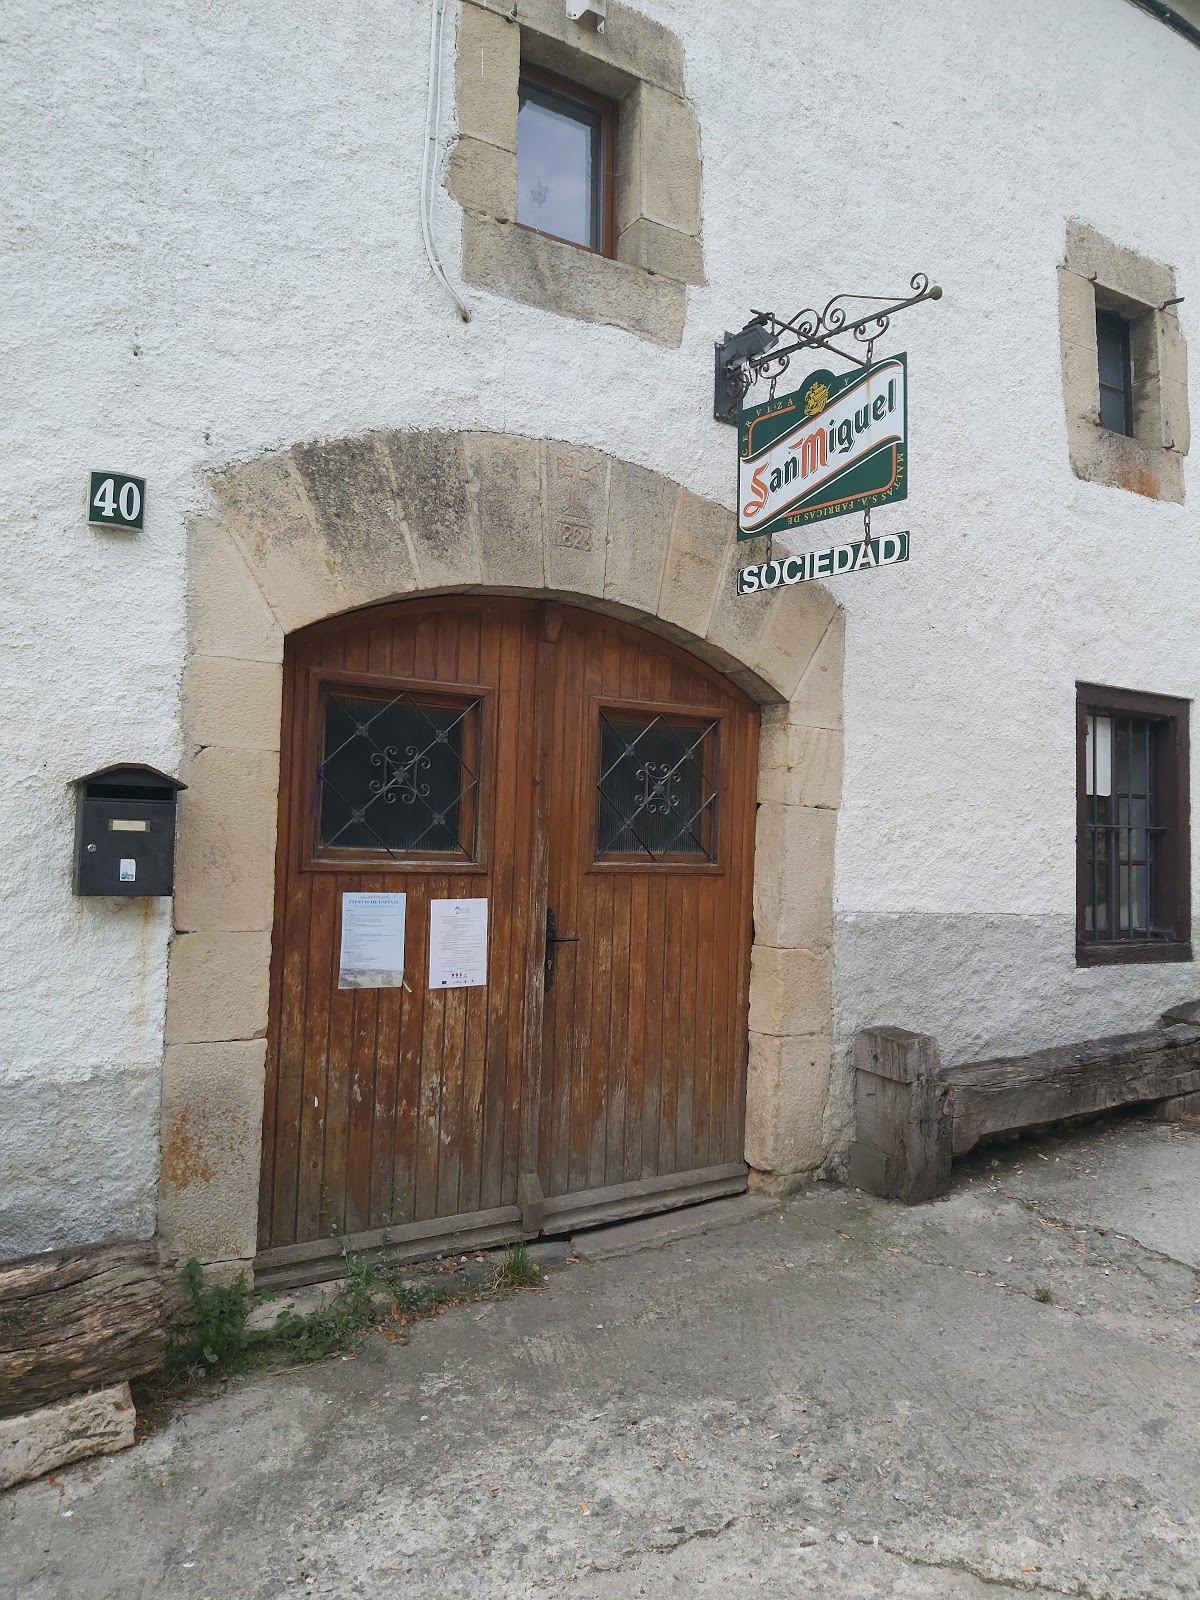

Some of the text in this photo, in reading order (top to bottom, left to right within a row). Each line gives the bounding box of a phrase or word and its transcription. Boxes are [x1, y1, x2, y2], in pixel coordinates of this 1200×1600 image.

[742, 398, 794, 456] CERVEZA
[881, 453, 904, 501] MALTAS
[743, 378, 896, 518] San Miguel
[93, 478, 141, 521] 40
[787, 501, 854, 525] FABRICAS DE
[741, 534, 901, 594] SOCIEDAD
